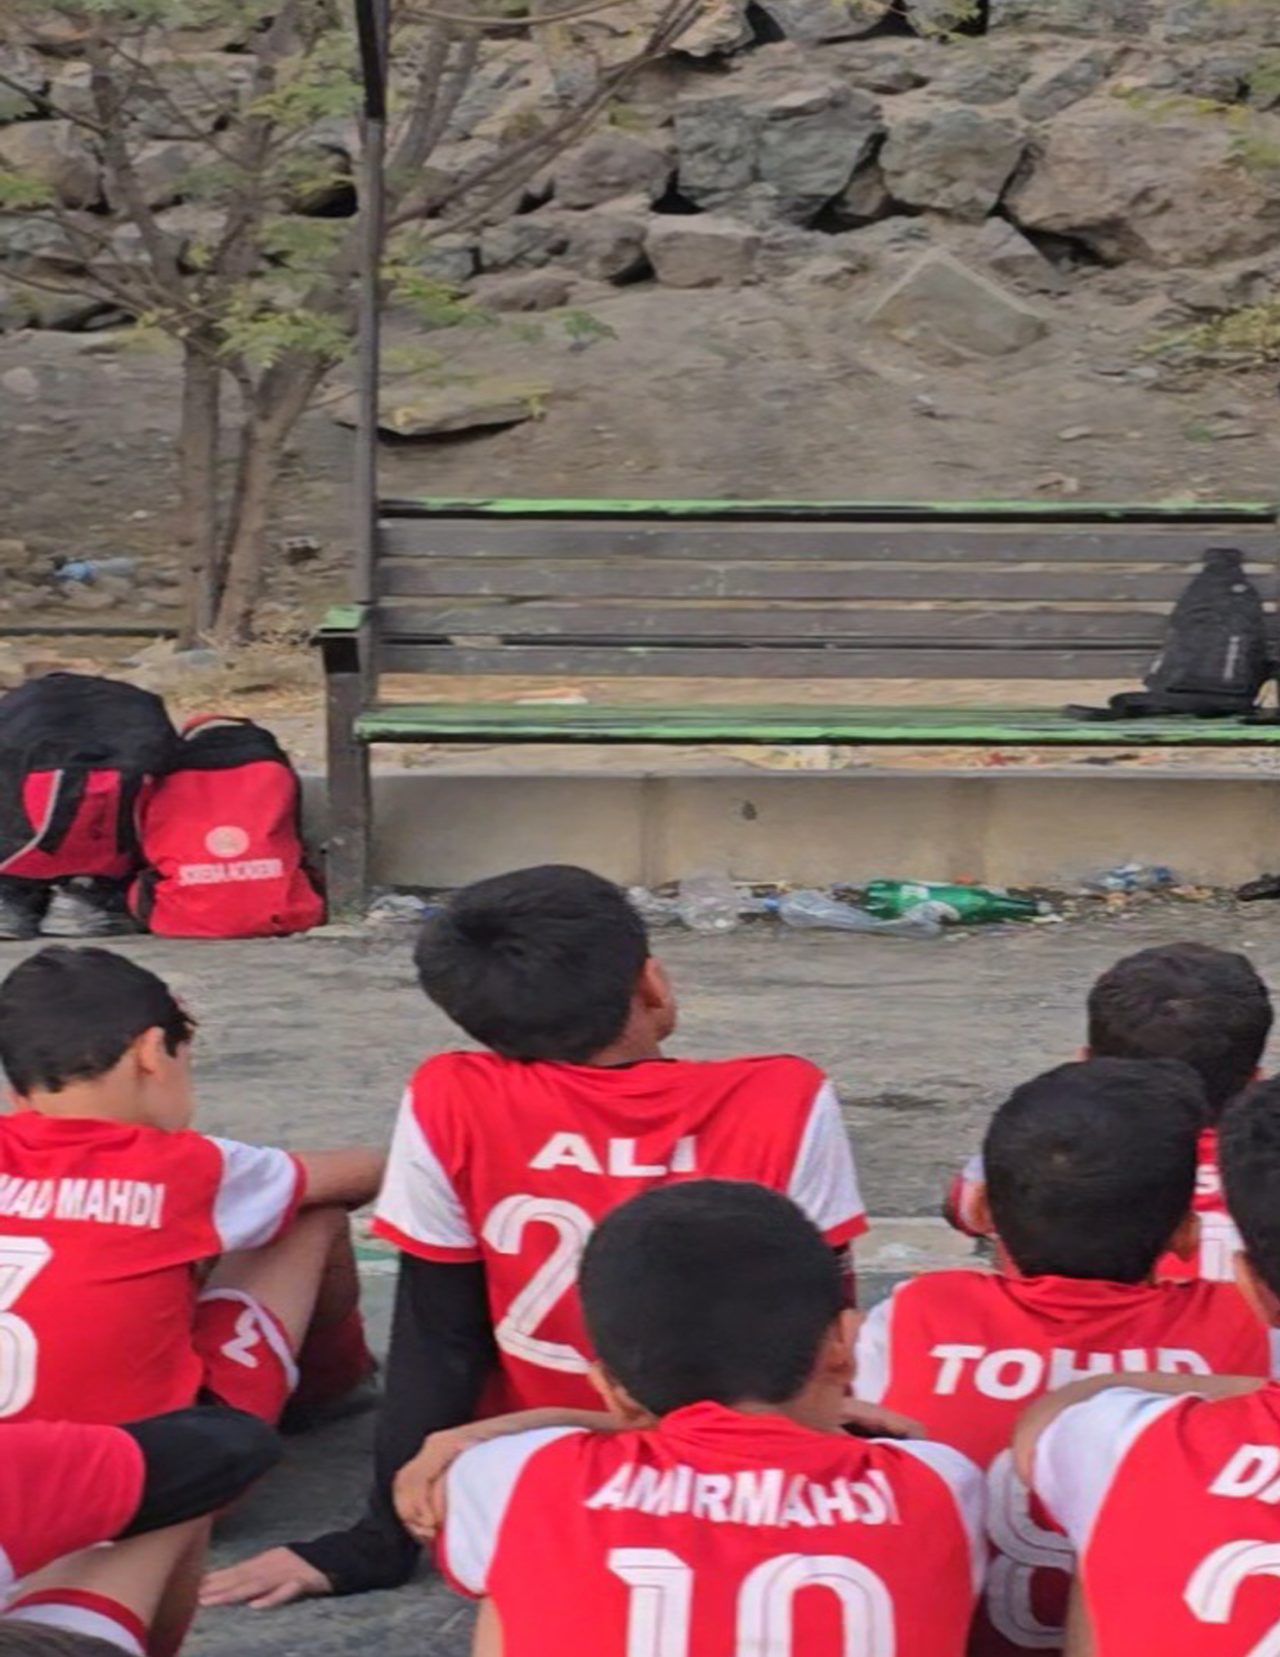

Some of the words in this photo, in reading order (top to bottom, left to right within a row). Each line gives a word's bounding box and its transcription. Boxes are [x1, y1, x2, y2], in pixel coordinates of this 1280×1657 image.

[528, 1131, 696, 1177] ALI
[54, 1177, 165, 1229] MAHDI
[482, 1193, 597, 1374] 2
